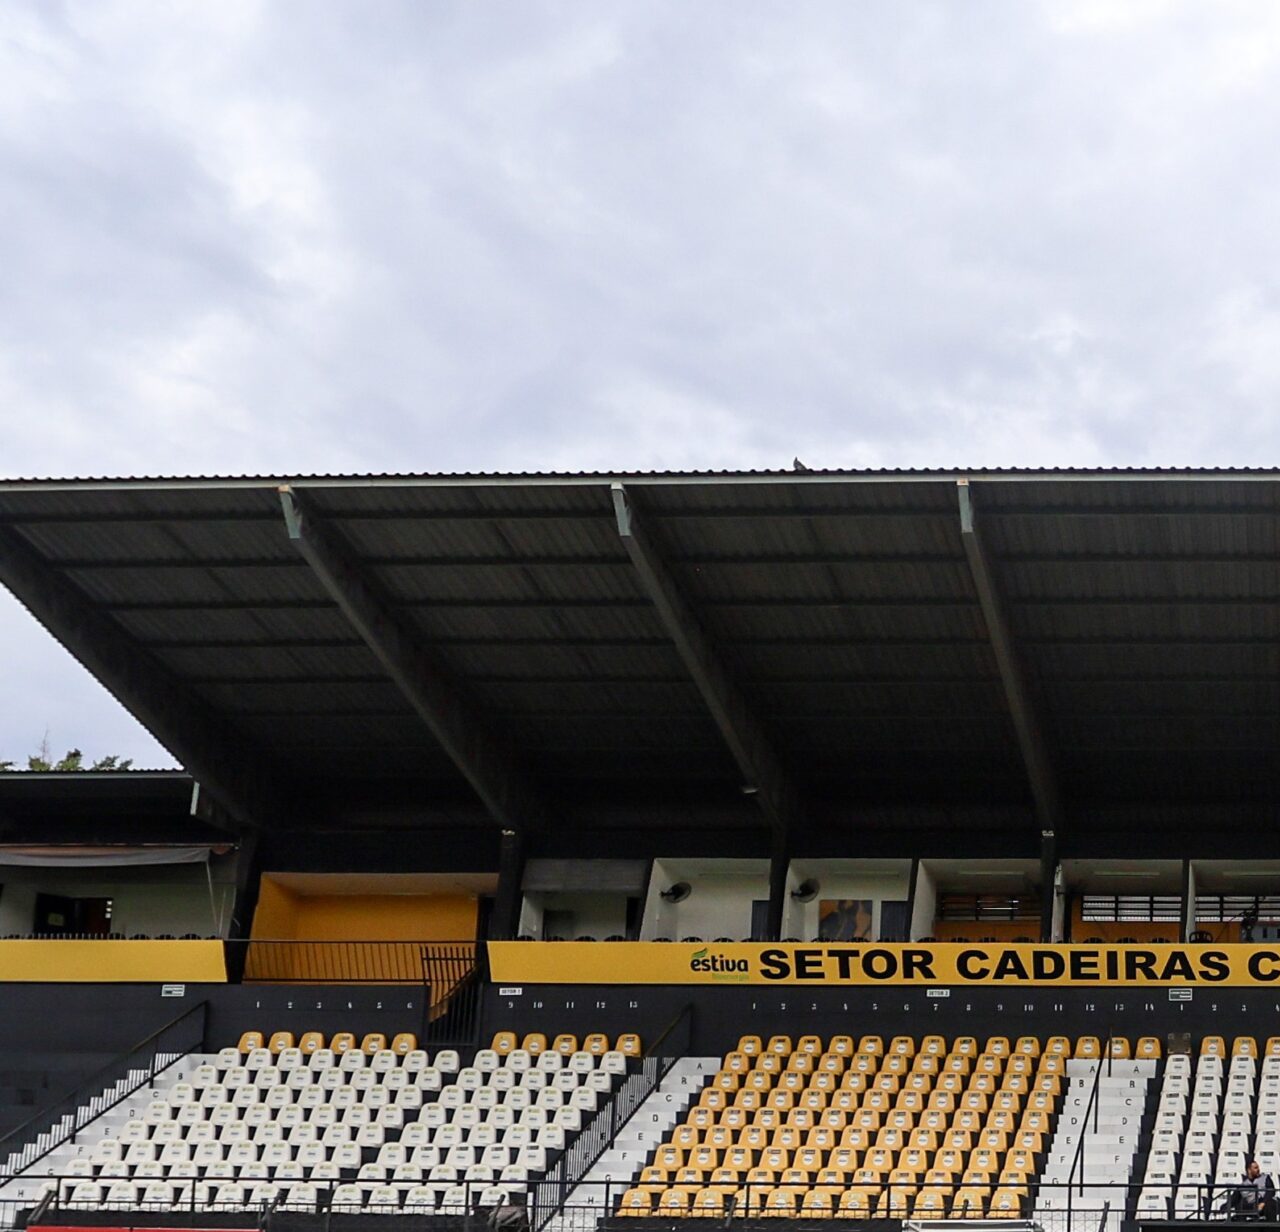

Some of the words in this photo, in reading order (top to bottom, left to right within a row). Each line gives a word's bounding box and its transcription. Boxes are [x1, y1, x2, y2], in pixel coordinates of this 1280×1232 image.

[690, 955, 749, 972] estiva
[759, 949, 937, 980] SETOR
[956, 949, 1230, 981] CADEIRAS
[533, 1001, 543, 1009] 10
[566, 1001, 575, 1009] 11
[596, 1001, 606, 1009] 12
[629, 1001, 638, 1009] 13
[1024, 1004, 1034, 1012] 10
[1054, 1003, 1063, 1012] 11
[1085, 1003, 1095, 1012] 12
[1114, 1003, 1125, 1011] 13
[1144, 1003, 1155, 1011] 14
